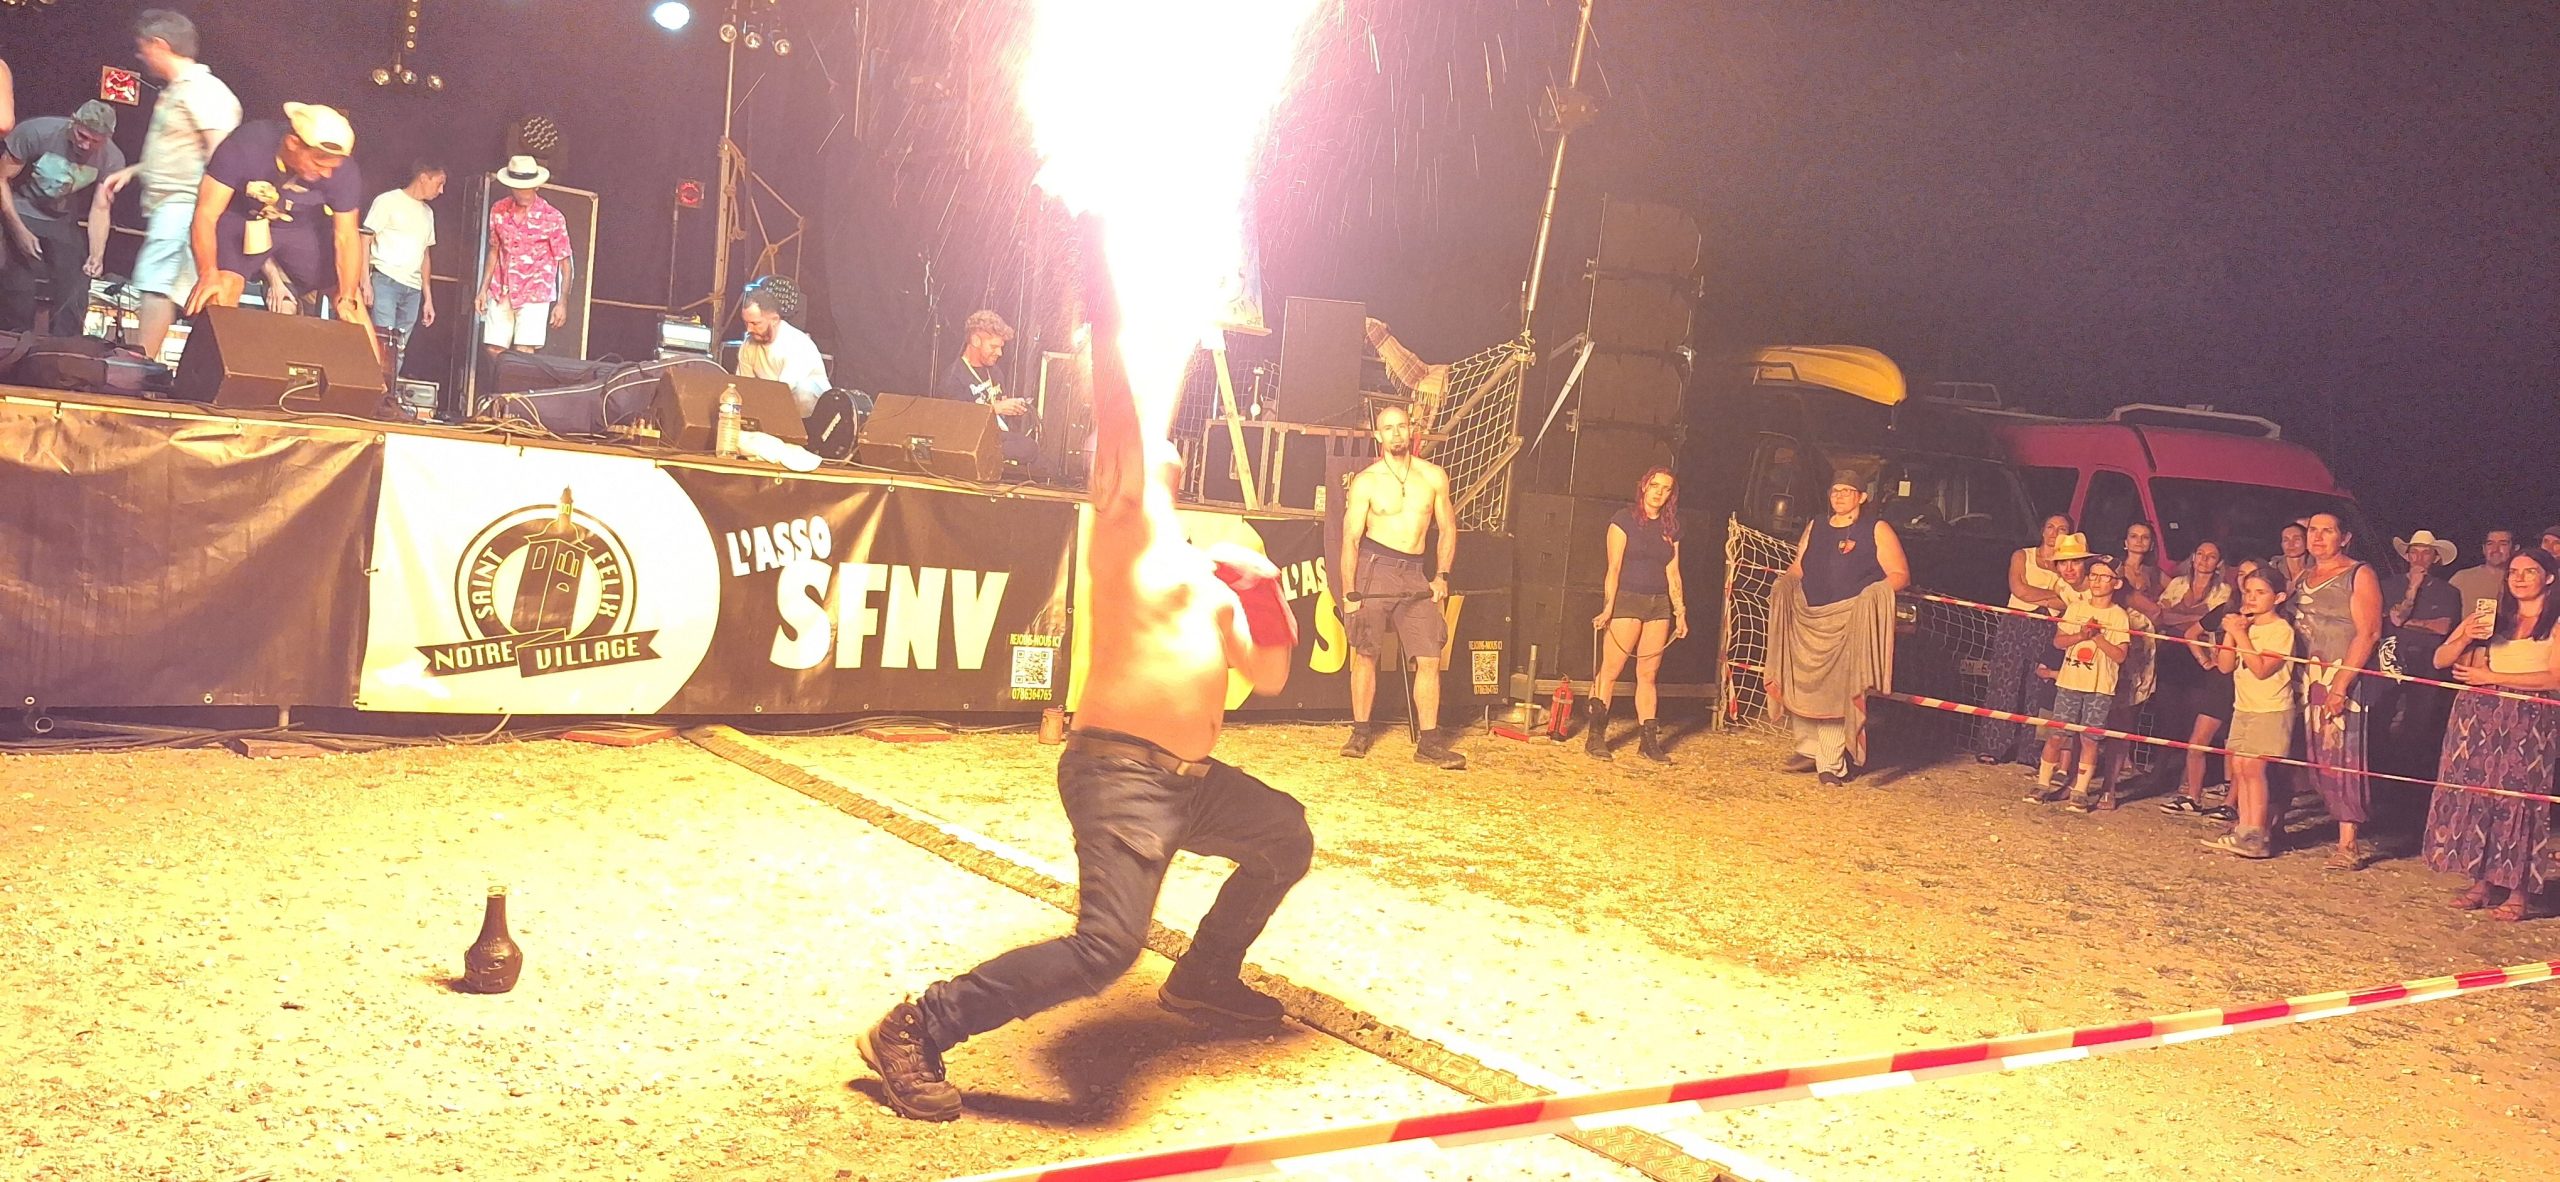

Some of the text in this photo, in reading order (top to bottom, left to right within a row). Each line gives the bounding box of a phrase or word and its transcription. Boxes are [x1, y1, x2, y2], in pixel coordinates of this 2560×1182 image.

[726, 515, 832, 577] L'ASSO
[471, 546, 504, 620] SAINT
[593, 551, 621, 618] FELIX
[1281, 556, 1329, 602] L'AS
[769, 559, 1010, 670] SFNV
[434, 636, 641, 672] NOTRE VILLAGE
